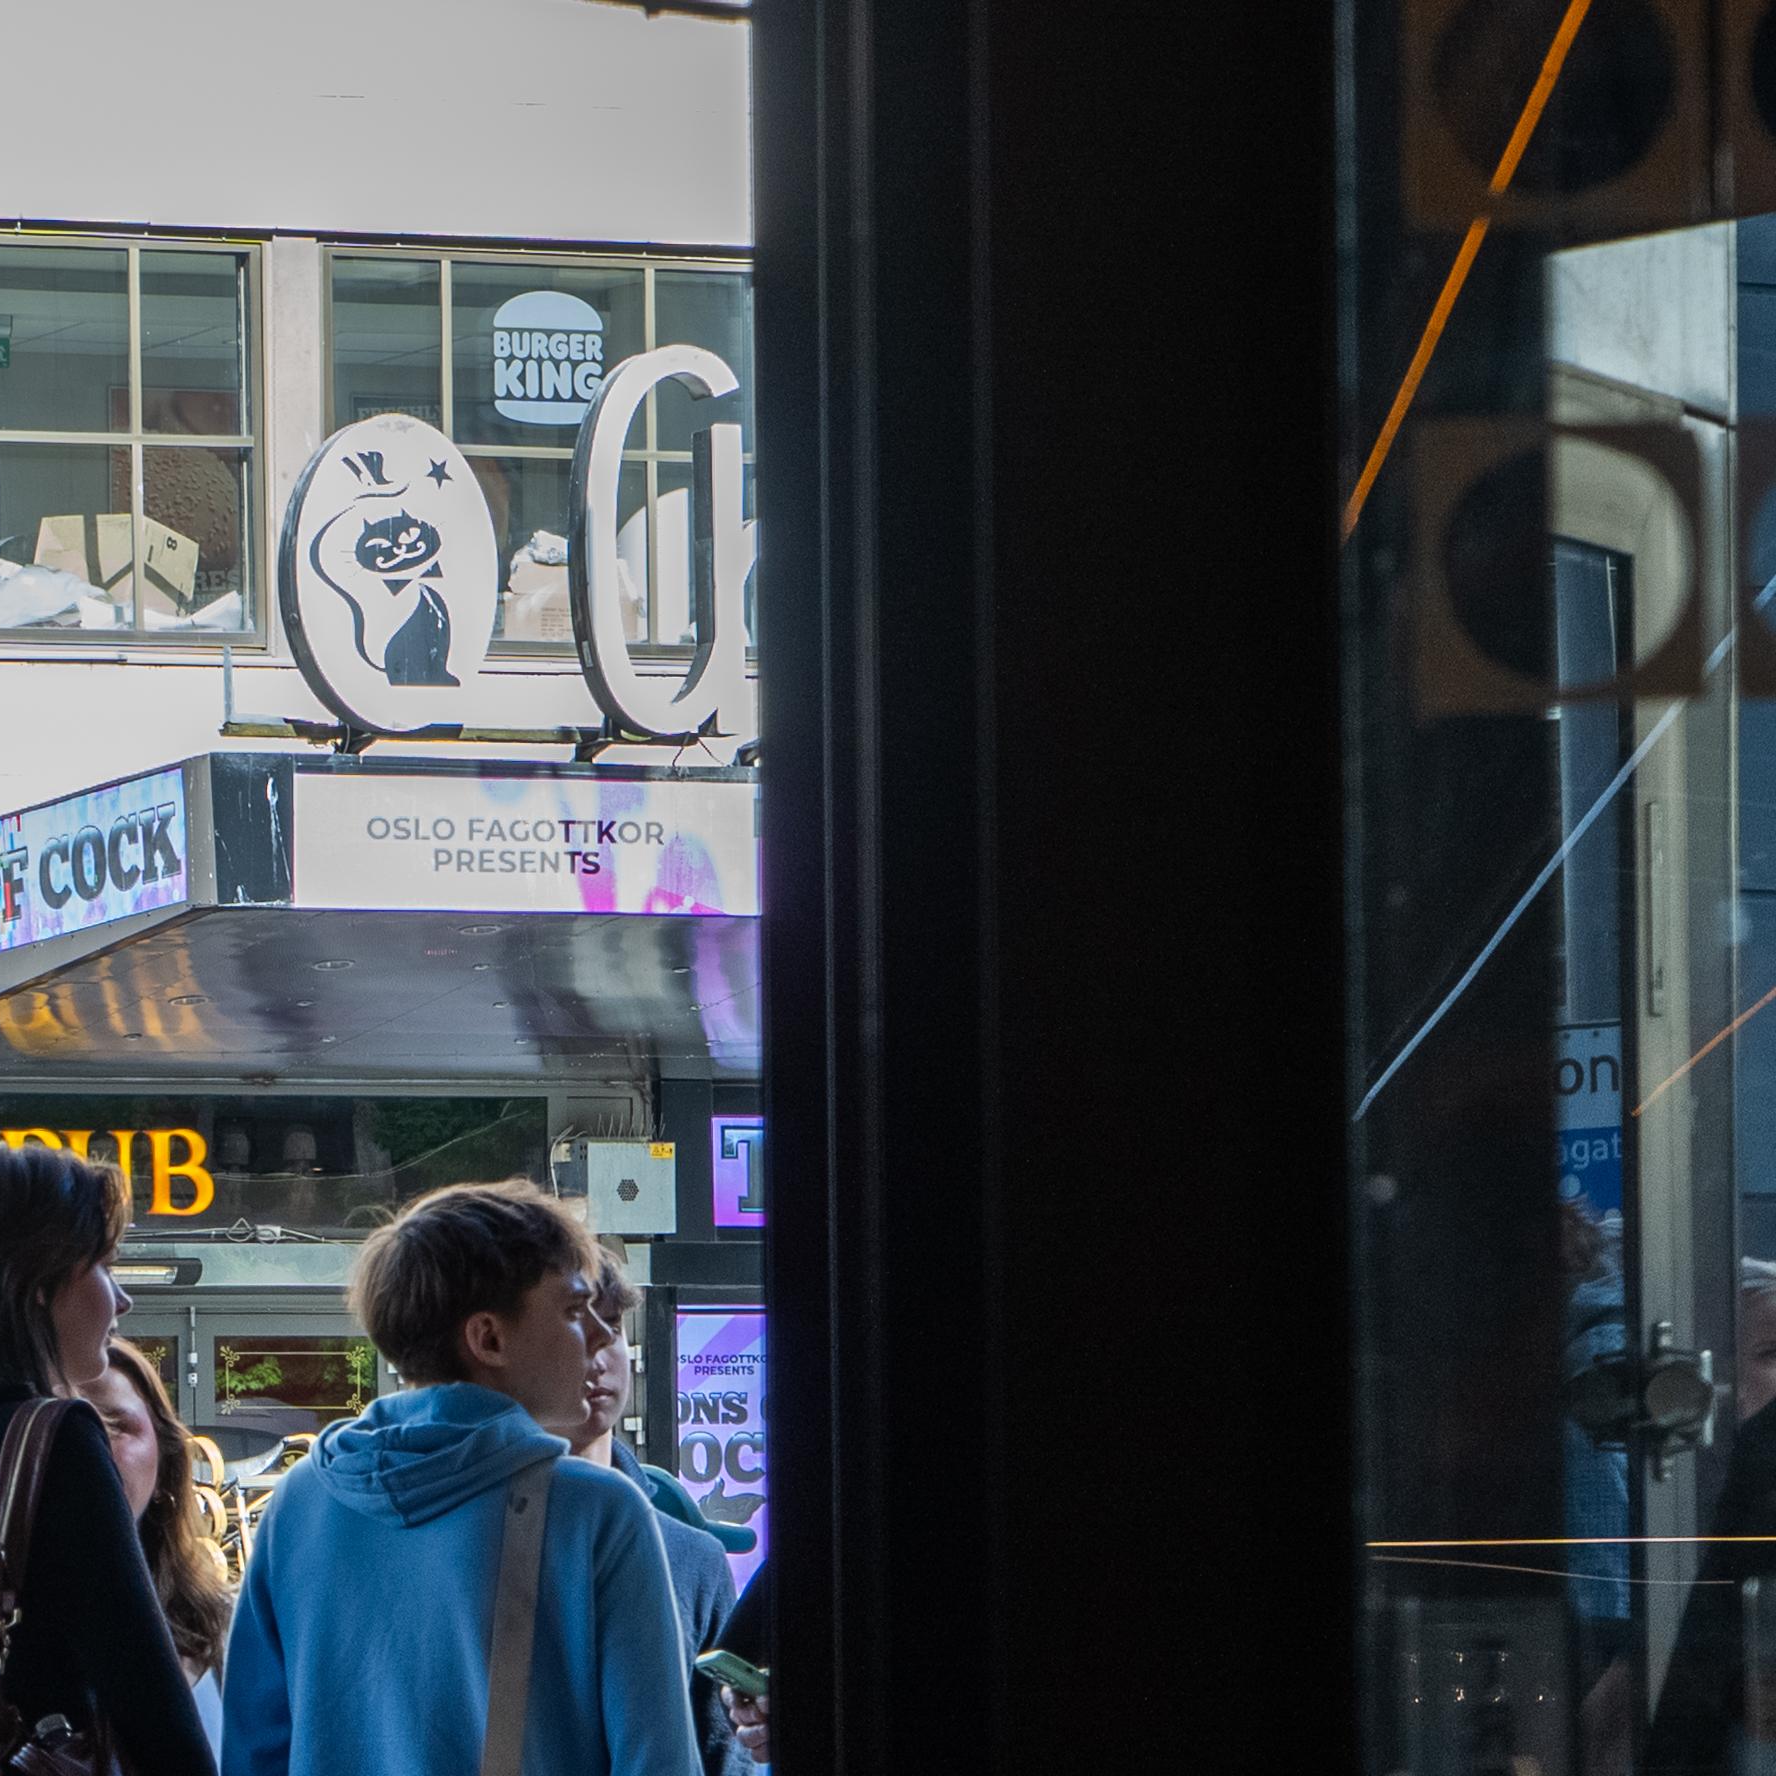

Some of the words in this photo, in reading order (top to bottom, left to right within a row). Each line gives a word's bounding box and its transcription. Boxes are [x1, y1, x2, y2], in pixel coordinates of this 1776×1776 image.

[493, 331, 604, 361] BURGER
[494, 358, 603, 400] KING
[367, 817, 455, 841] OSLO
[468, 818, 665, 845] FAGOTTKOR
[39, 801, 182, 910] COCK
[433, 848, 601, 875] PRESENTS
[694, 1365, 755, 1376] PRESENTS
